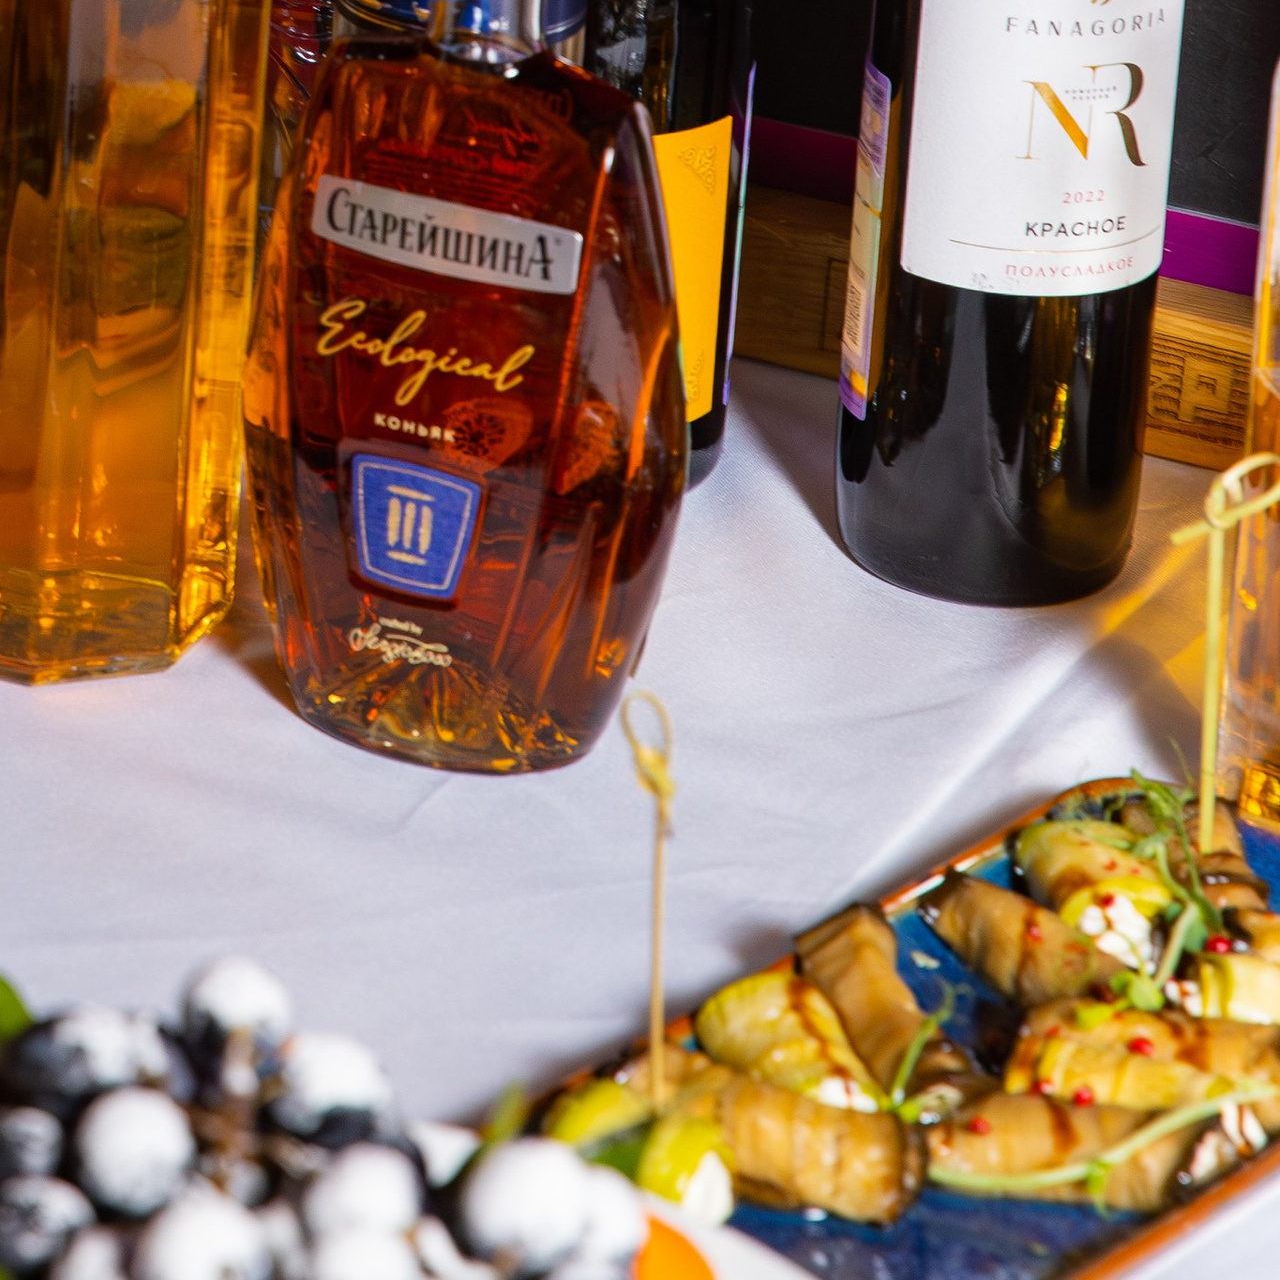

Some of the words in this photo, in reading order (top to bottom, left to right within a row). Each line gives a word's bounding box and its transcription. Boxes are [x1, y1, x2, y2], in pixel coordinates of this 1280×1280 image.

[1006, 8, 1165, 37] FANAGORIA
[1062, 189, 1106, 205] 2022
[1025, 215, 1127, 238] КРАСНОЕ
[1005, 256, 1134, 278] ПОЛУСЛАДКОЕ
[317, 299, 535, 406] Ecological
